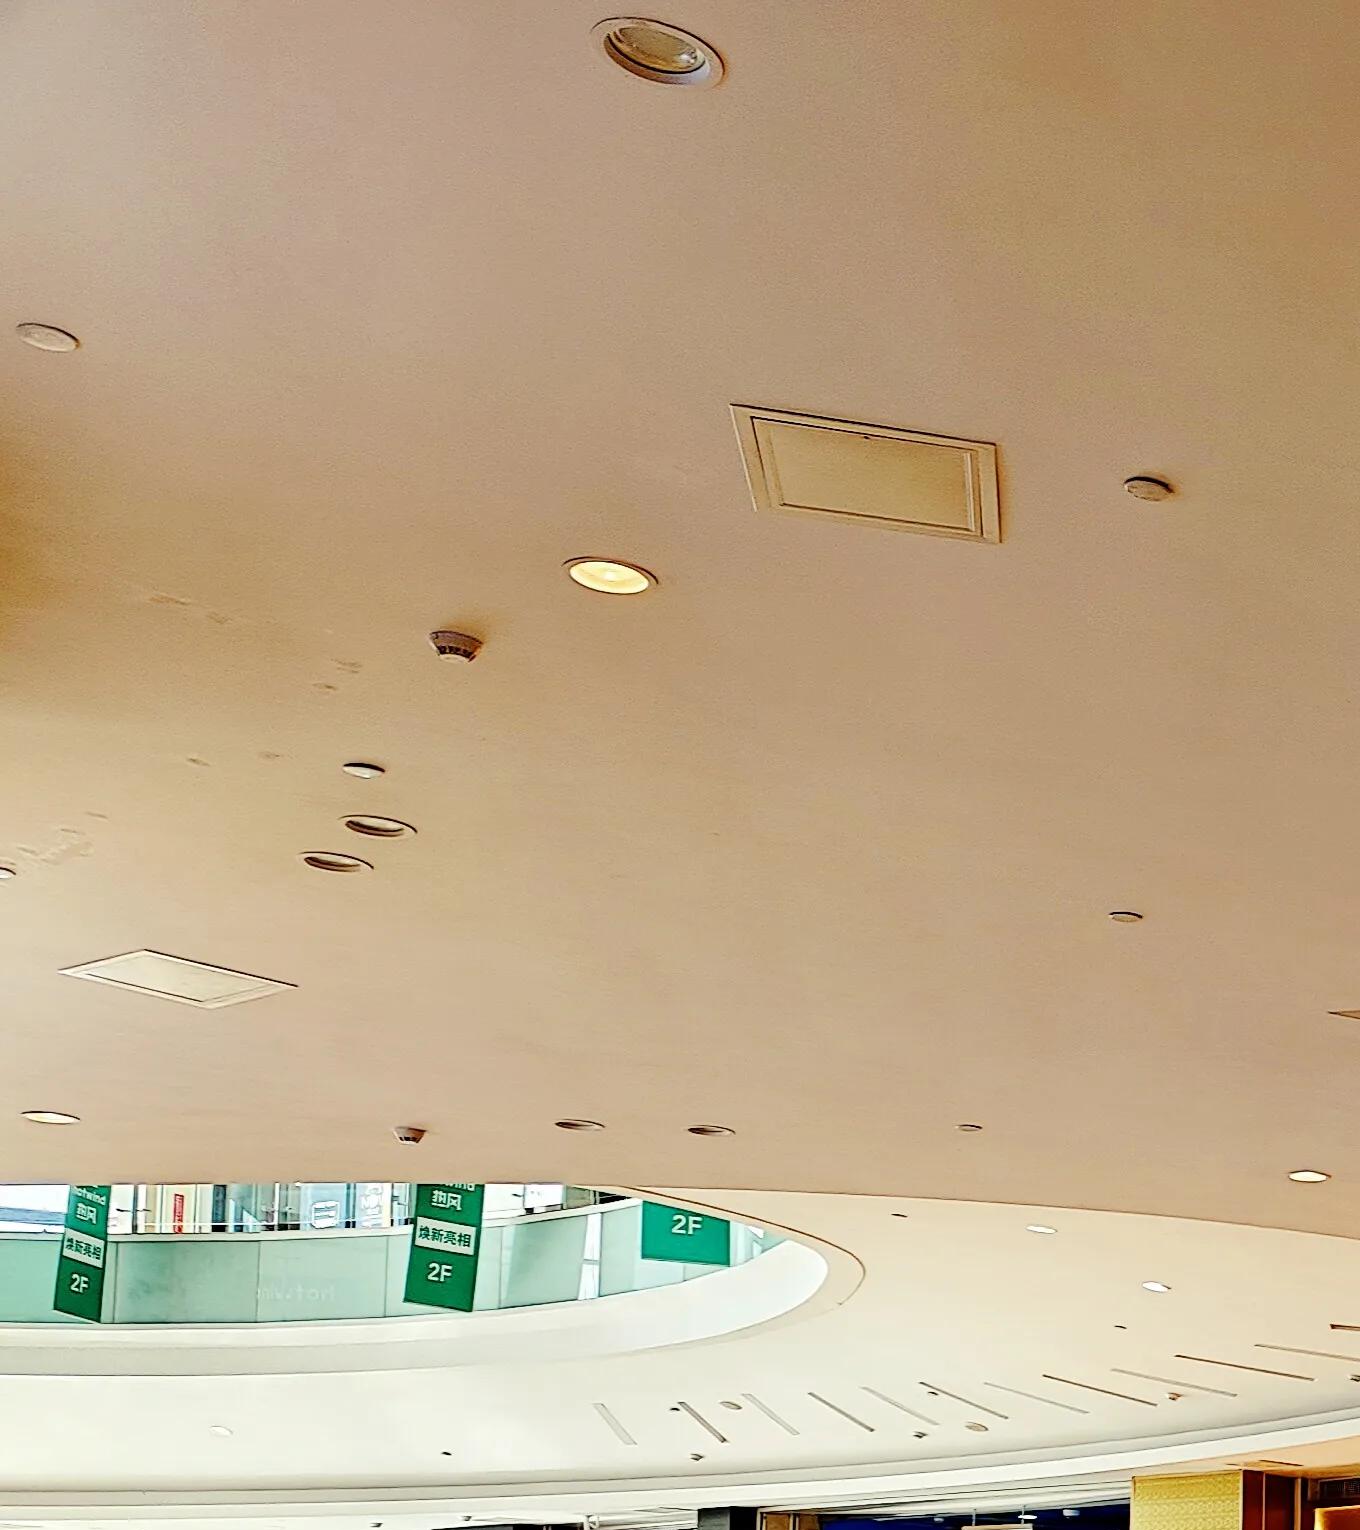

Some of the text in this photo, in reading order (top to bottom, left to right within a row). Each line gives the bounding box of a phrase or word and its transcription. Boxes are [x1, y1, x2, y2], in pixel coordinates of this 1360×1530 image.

[670, 1214, 703, 1235] 2F
[427, 1262, 453, 1283] 2F
[69, 1273, 89, 1294] 2F
